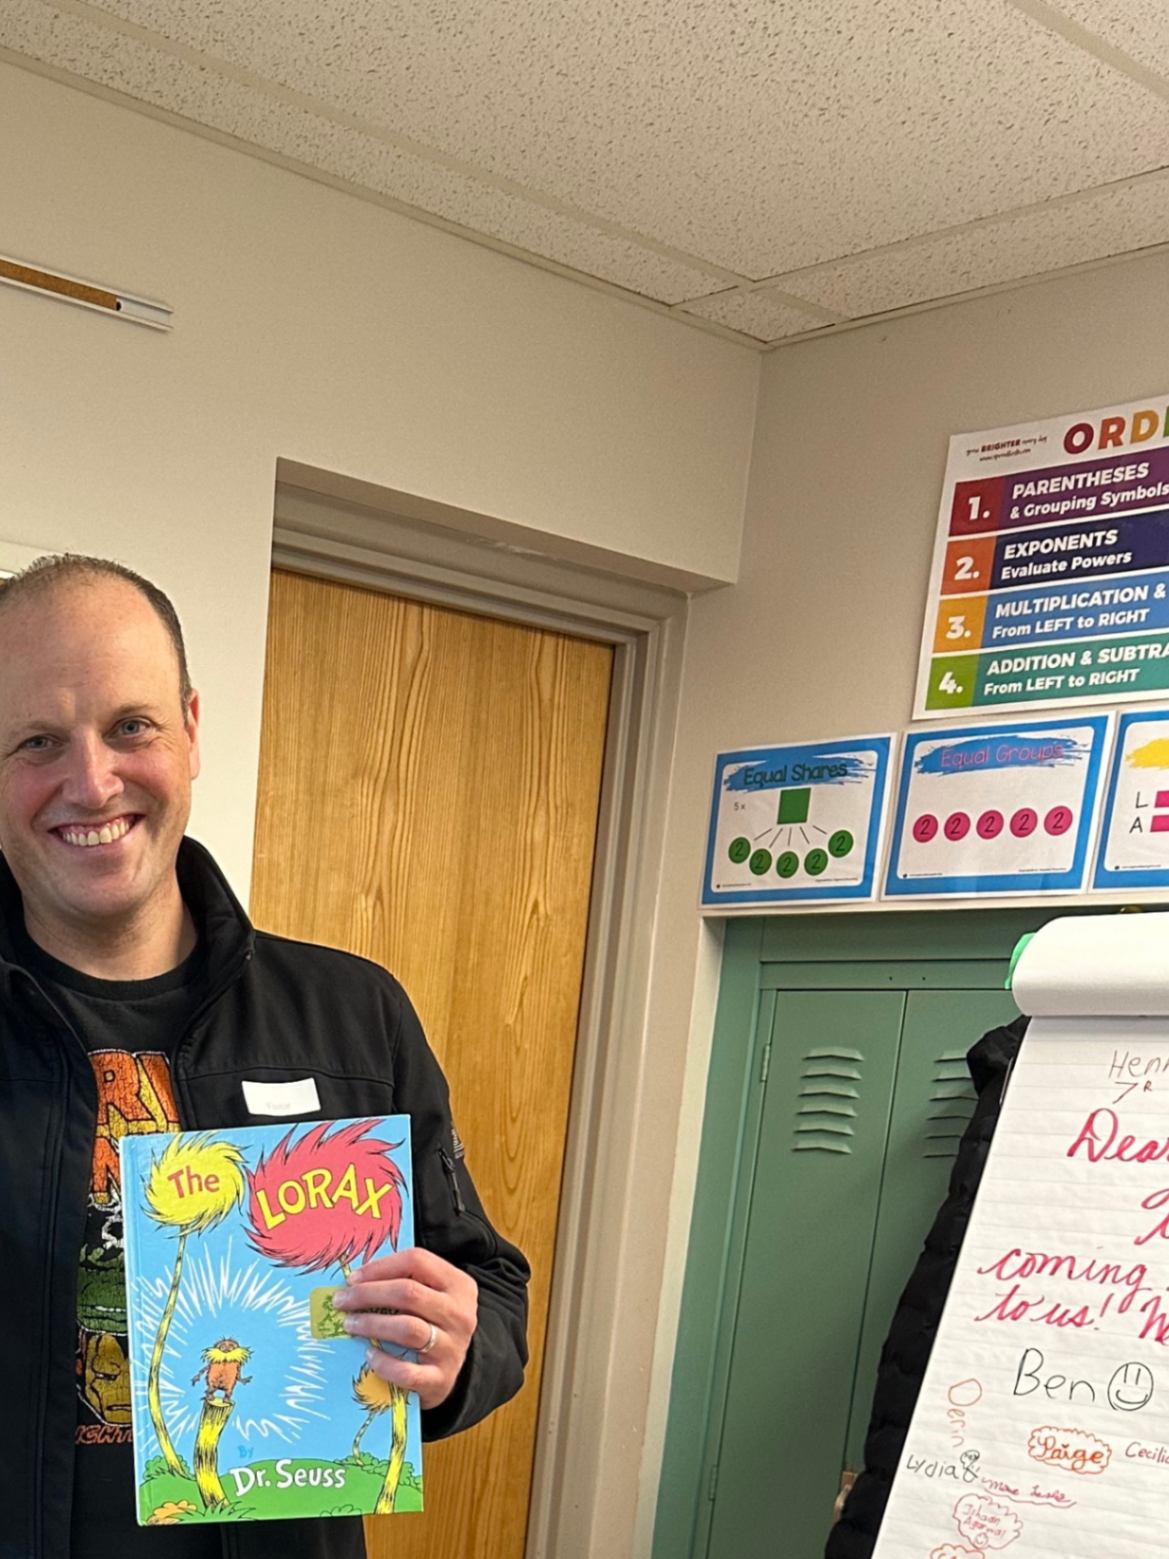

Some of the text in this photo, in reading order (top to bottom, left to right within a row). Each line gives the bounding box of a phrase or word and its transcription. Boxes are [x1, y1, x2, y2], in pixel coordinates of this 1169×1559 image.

[1063, 404, 1169, 455] ORD
[968, 462, 1150, 520] 1. PARENTHESES
[1010, 482, 1169, 519] & Grouping Symbols
[954, 529, 1119, 580] 2. EXPONENTS
[1001, 551, 1133, 580] Evaluate Powers
[945, 583, 1166, 639] 3. MULTIPLICATION &
[992, 608, 1150, 639] From LEFT to RIGHT
[938, 671, 964, 694] 4.
[986, 652, 1076, 676] ADDITION
[1080, 650, 1092, 665] &
[983, 668, 1140, 696] From LEFT to RIGHT
[940, 742, 1064, 769] Equal Groups
[743, 763, 848, 787] Equal Shares
[920, 811, 1066, 835] 2 2 2 2 2
[1066, 1107, 1169, 1162] Dea
[167, 1163, 393, 1230] The LORAX
[977, 1248, 1152, 1314] coming
[1012, 1348, 1095, 1402] Ben
[906, 1454, 959, 1480] Lydia
[1037, 1435, 1104, 1471] Paige
[230, 1460, 345, 1497] Dr. Seuss
